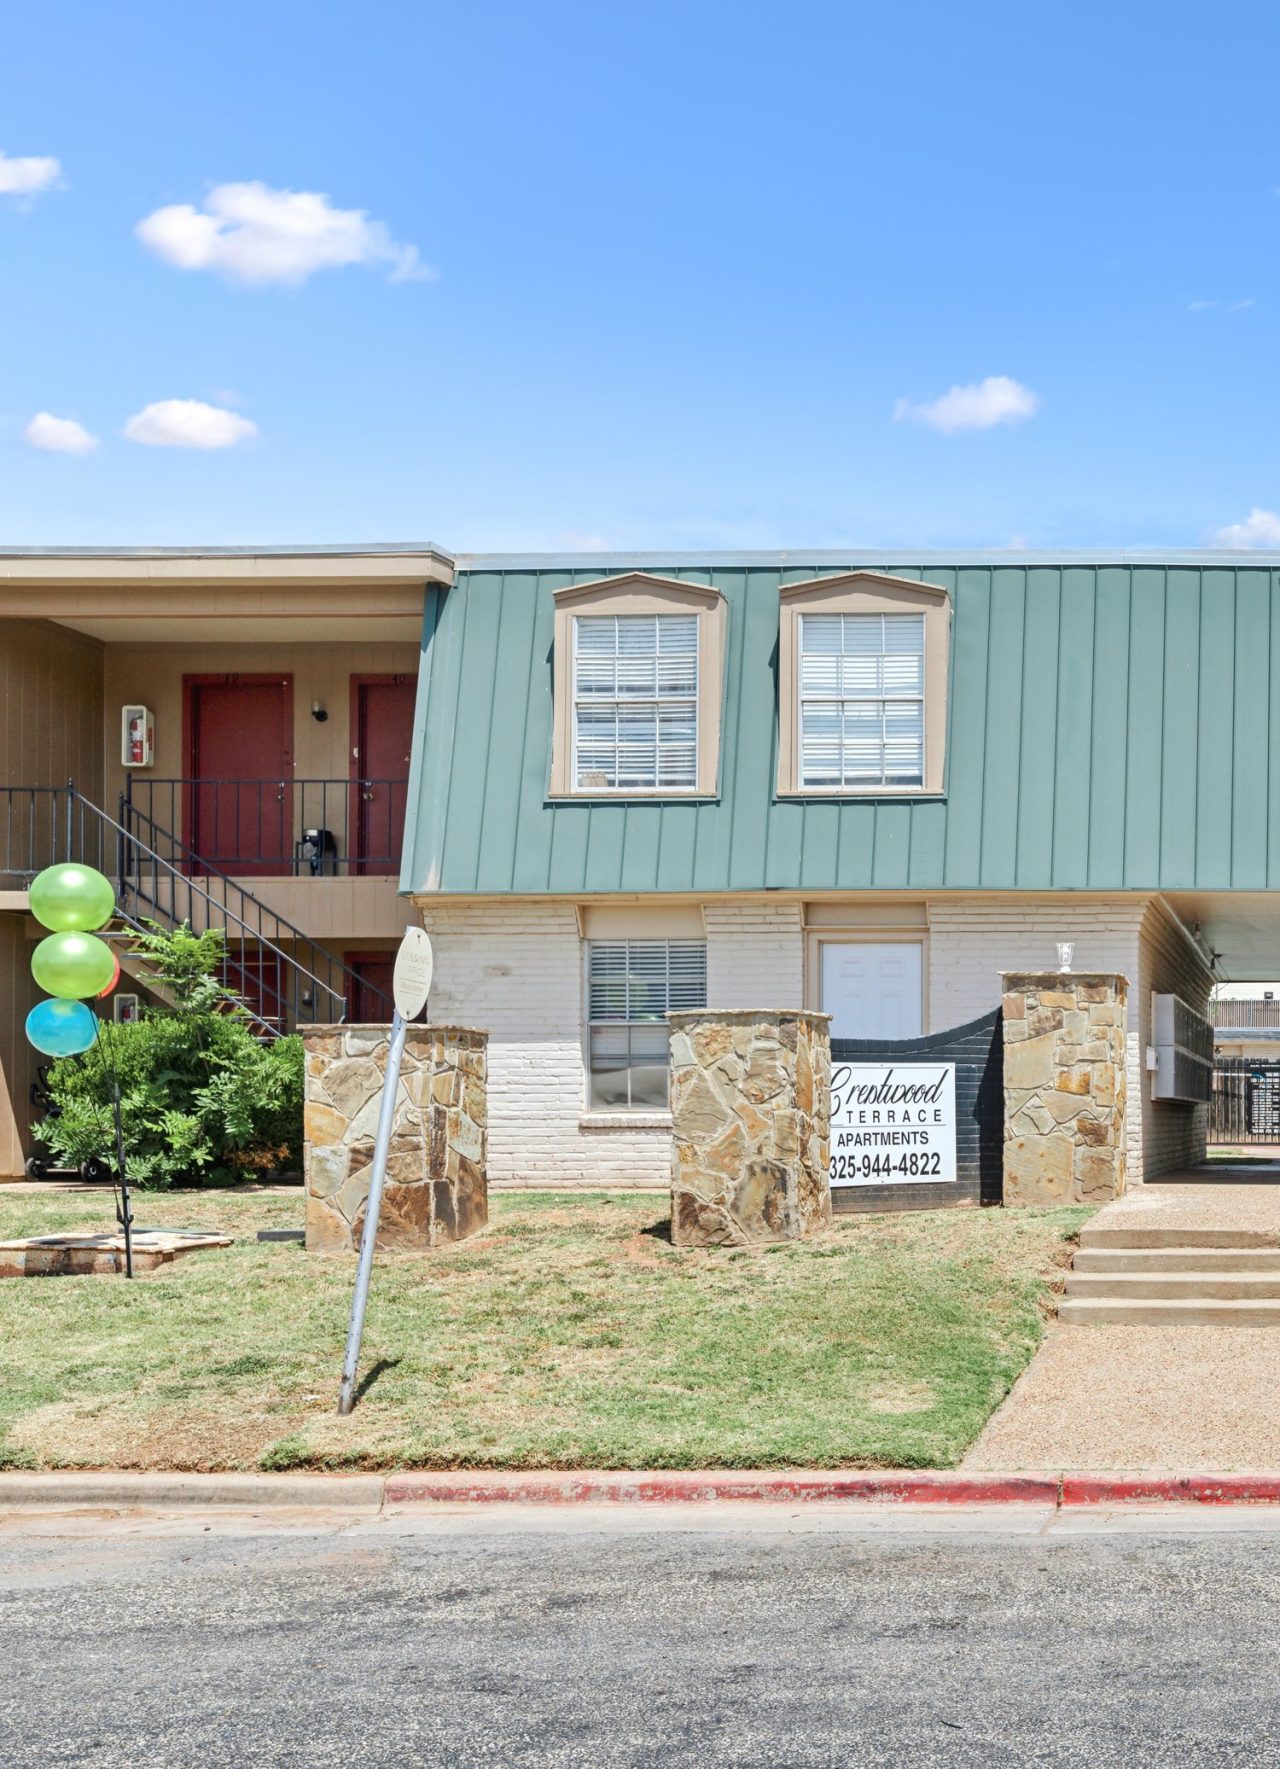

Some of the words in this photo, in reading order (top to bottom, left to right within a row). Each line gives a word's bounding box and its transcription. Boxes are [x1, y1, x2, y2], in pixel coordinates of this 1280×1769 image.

[402, 951, 431, 966] LEASING
[846, 1109, 942, 1124] TERRACE
[837, 1131, 929, 1147] APARTMENTS
[829, 1152, 941, 1180] 325-944-4822
